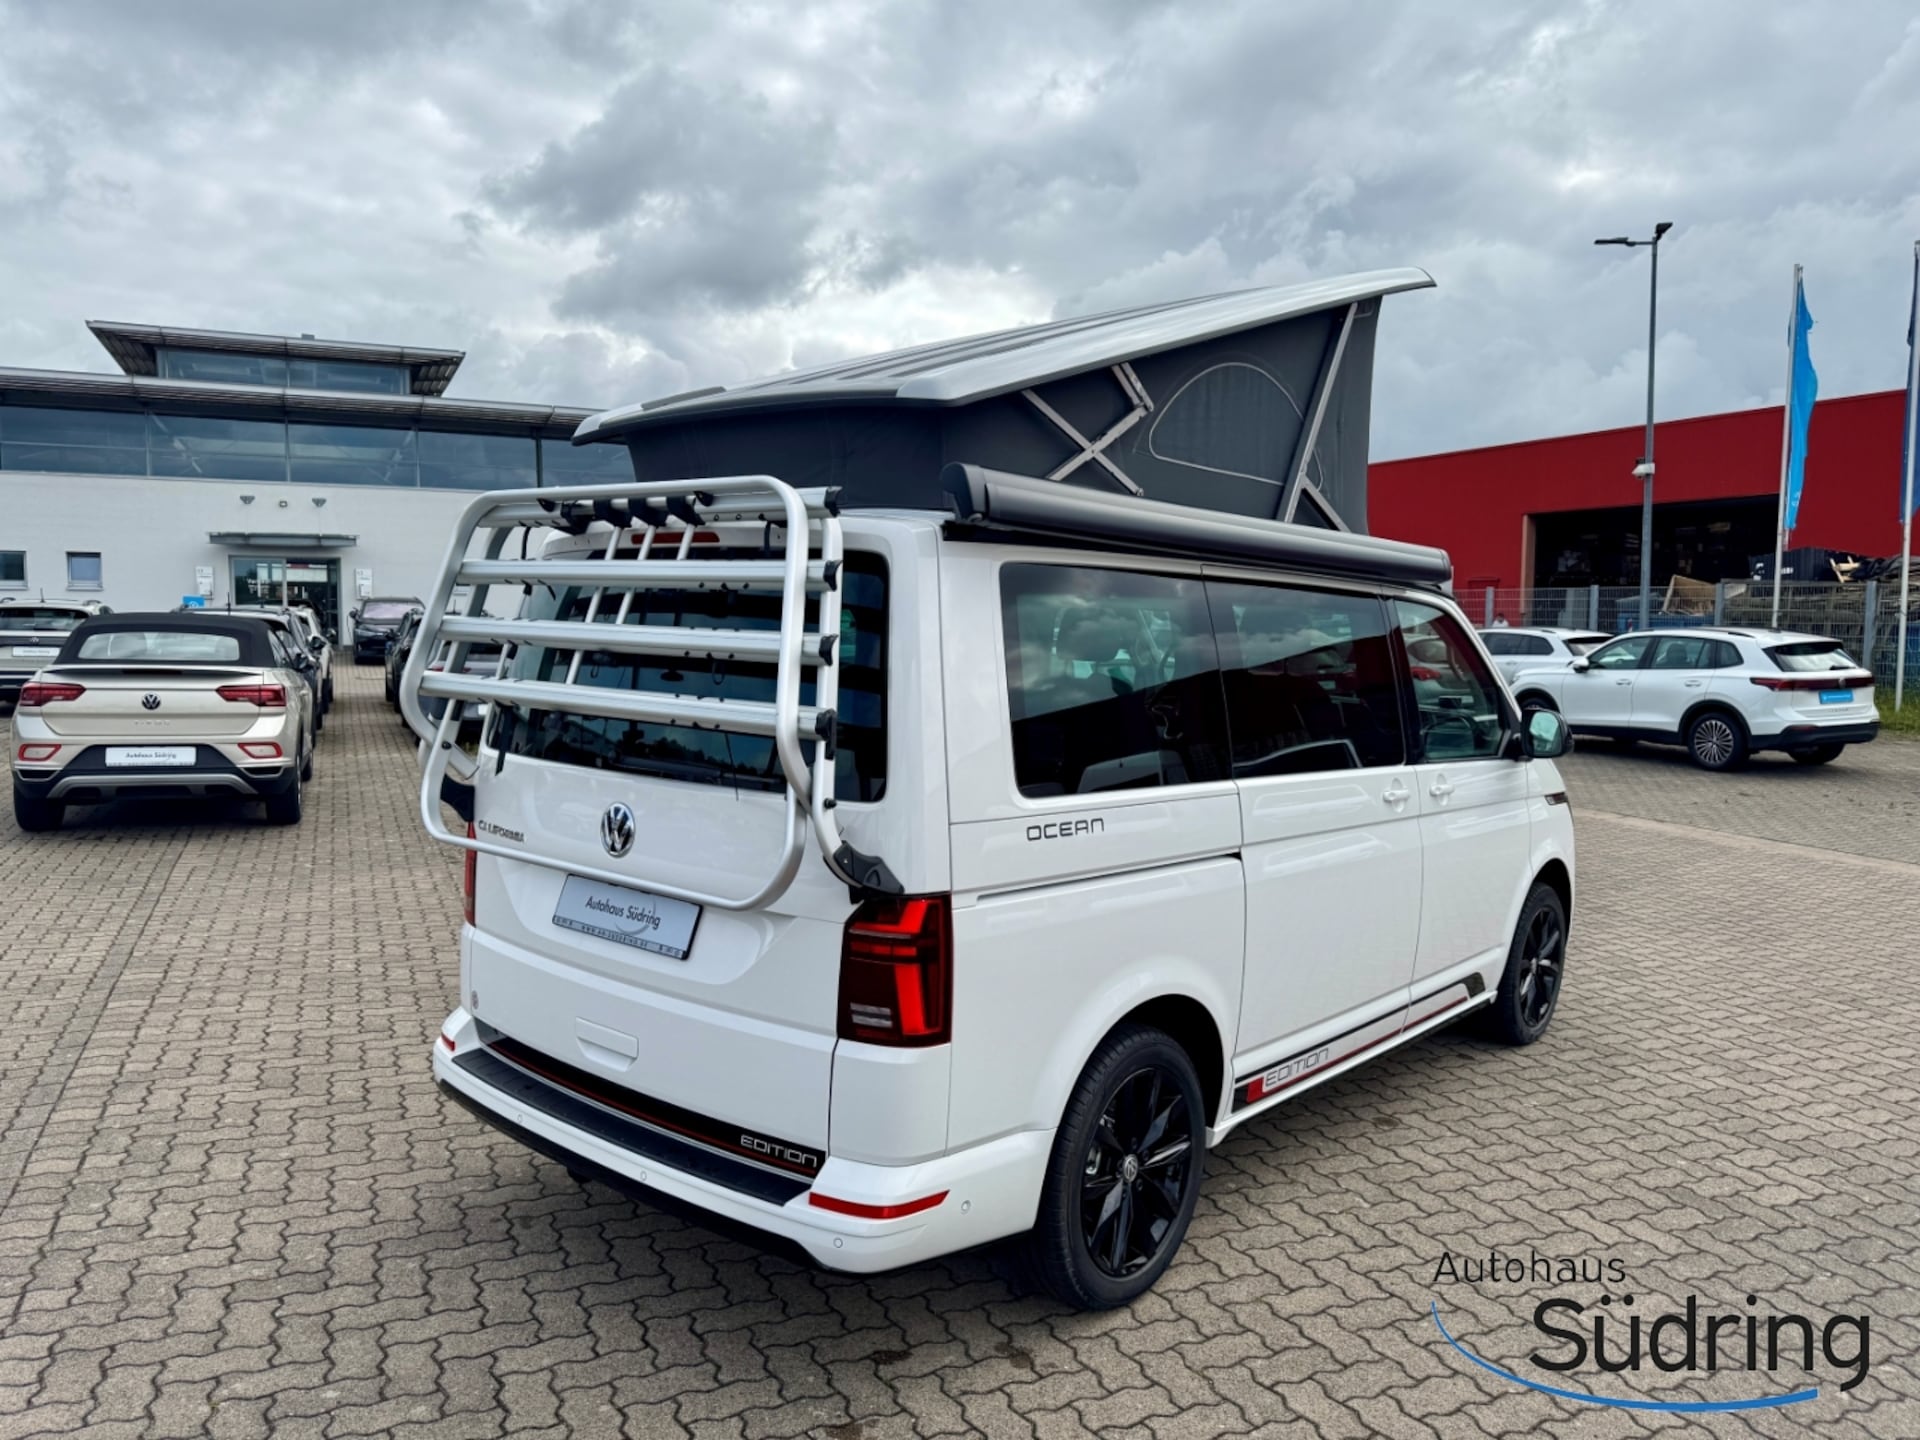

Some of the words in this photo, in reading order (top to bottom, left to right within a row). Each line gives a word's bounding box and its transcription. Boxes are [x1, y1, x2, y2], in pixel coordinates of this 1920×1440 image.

[1026, 817, 1105, 842] OCEAN
[585, 895, 625, 918] Autohaus
[626, 905, 662, 931] Südring
[1265, 1047, 1329, 1088] EDITION
[740, 1134, 818, 1169] EDITION
